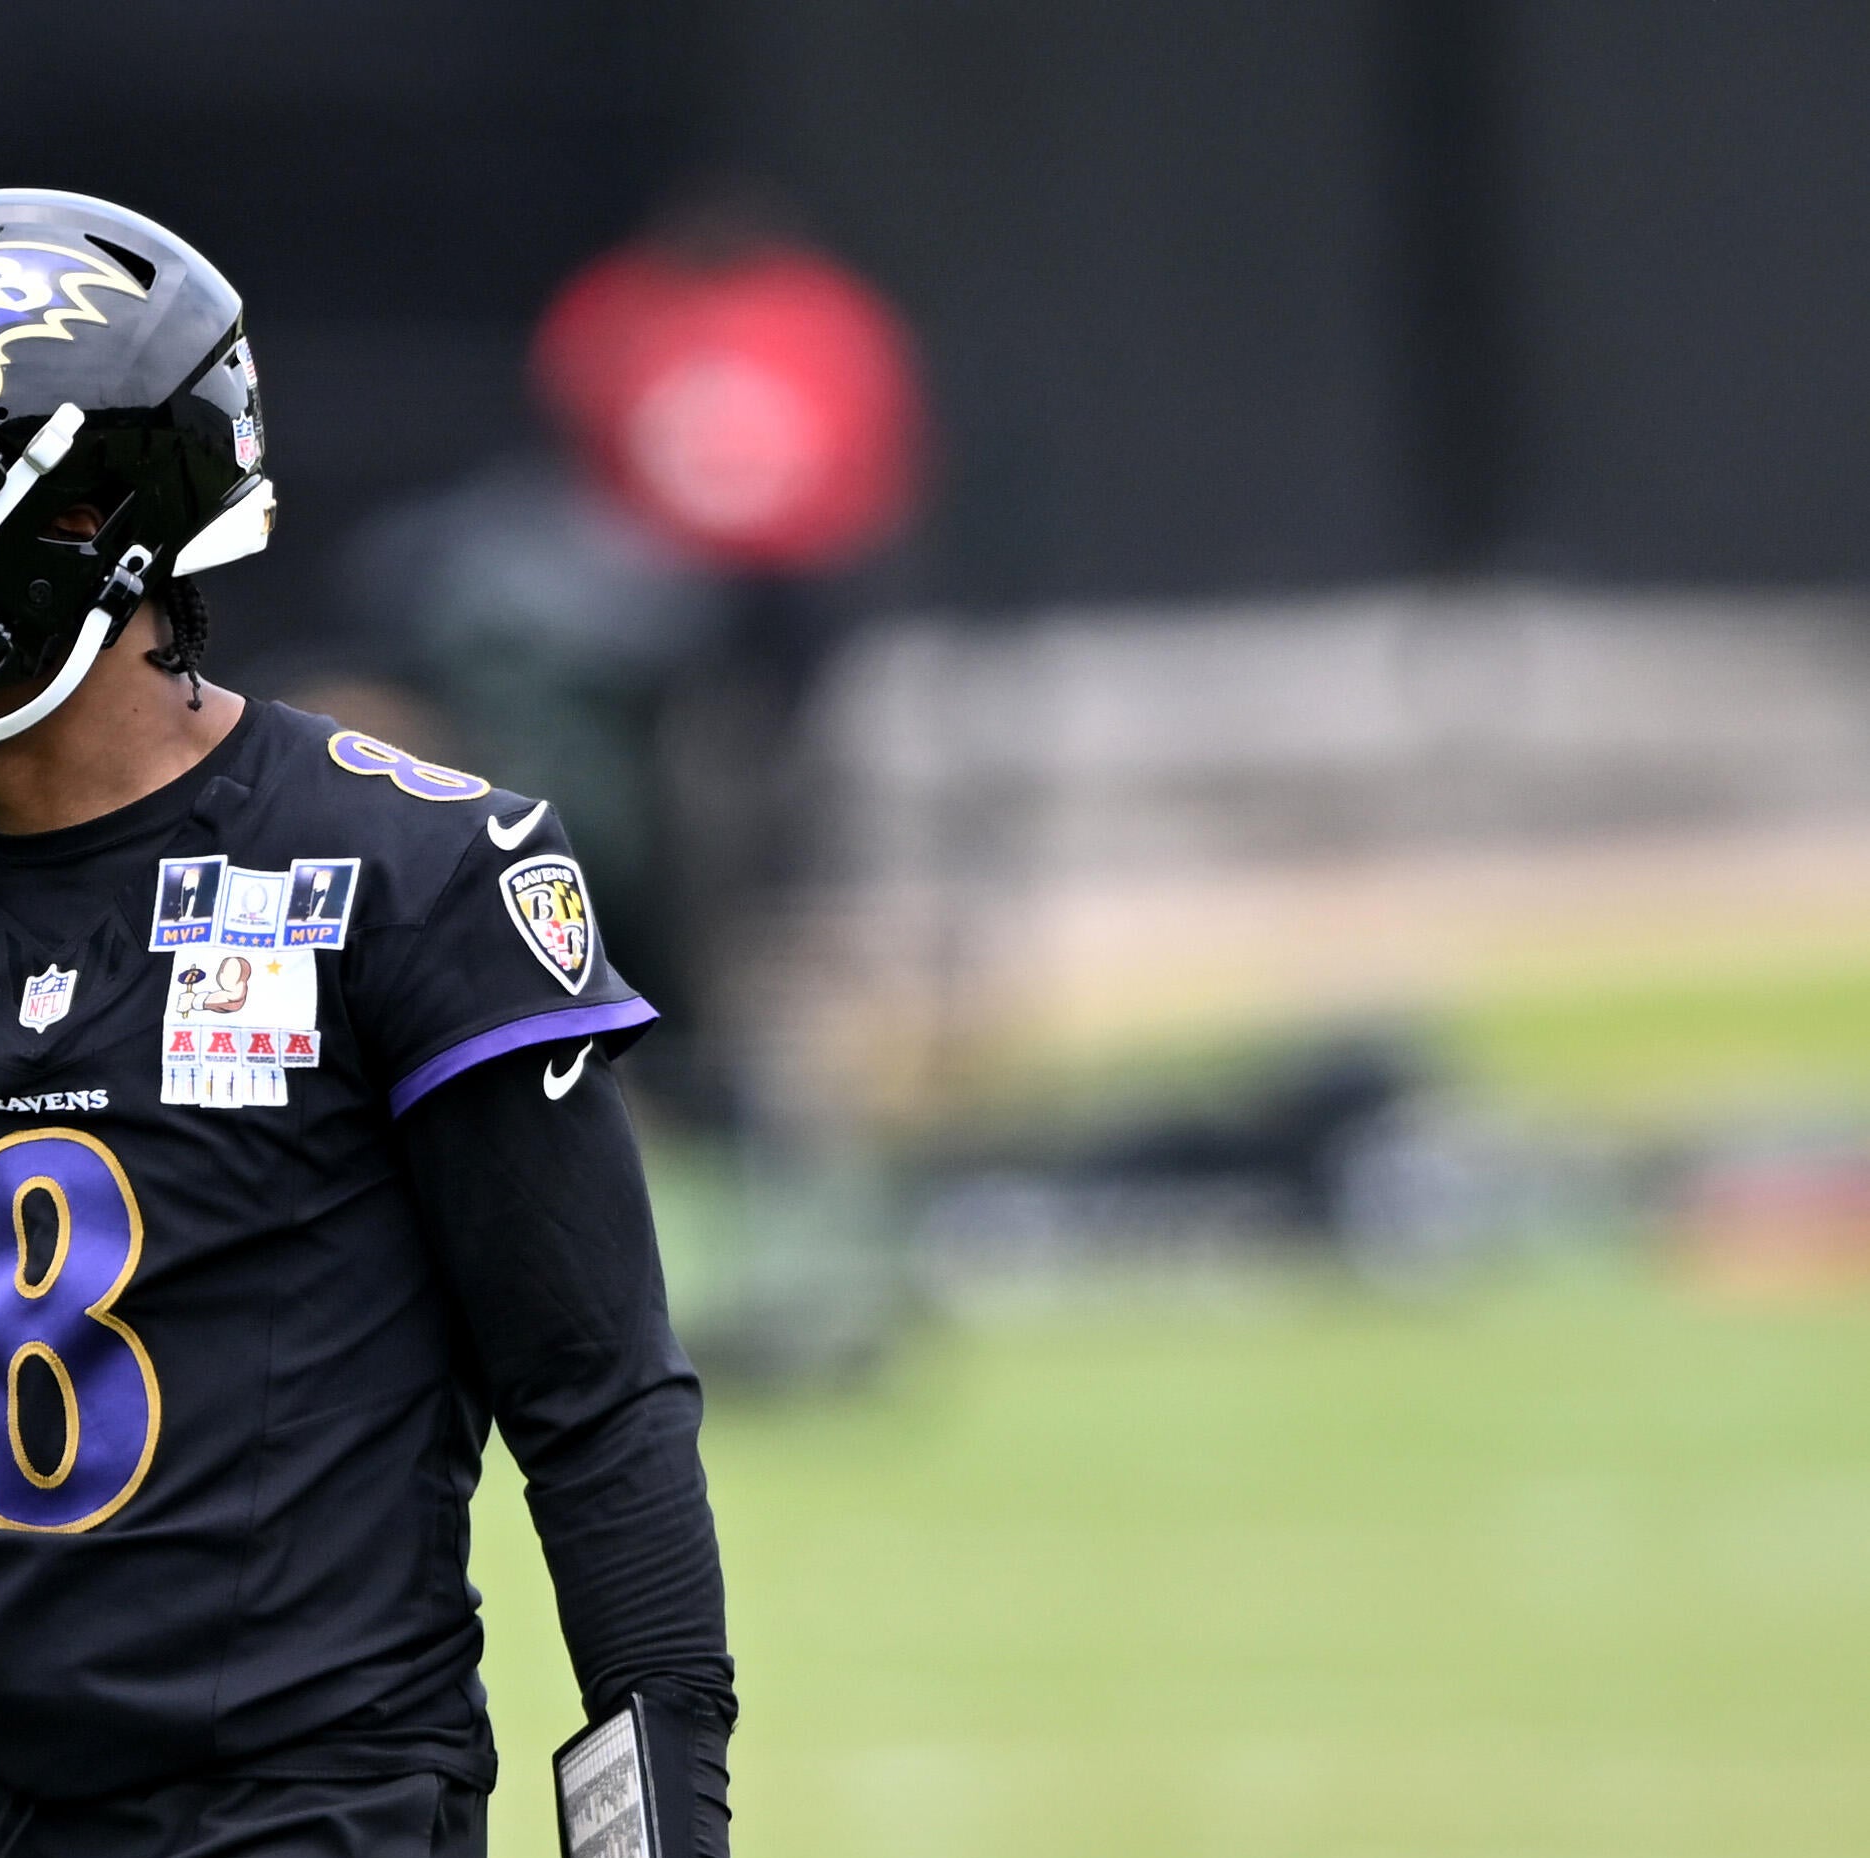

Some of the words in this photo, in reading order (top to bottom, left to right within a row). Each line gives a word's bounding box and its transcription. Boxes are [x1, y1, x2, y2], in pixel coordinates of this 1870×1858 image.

[327, 730, 492, 801] 8
[511, 866, 575, 892] RAVENS
[163, 926, 206, 944] MVP
[290, 926, 333, 943] MVP
[28, 994, 59, 1018] NFL
